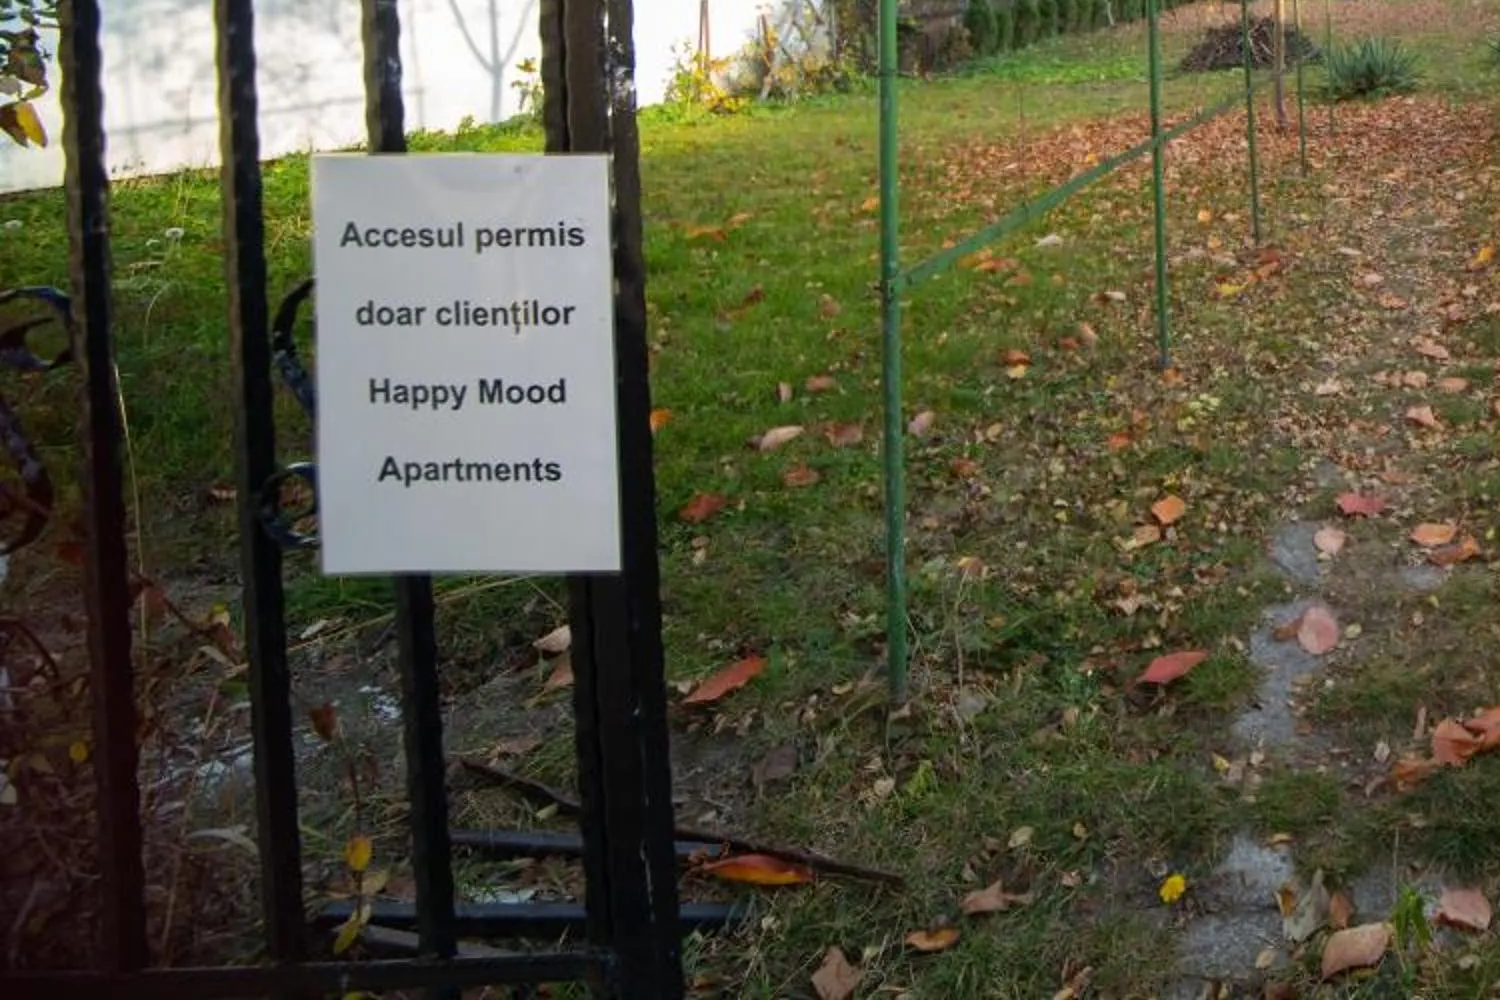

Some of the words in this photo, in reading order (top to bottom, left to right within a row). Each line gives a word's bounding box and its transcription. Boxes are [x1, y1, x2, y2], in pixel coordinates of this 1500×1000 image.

[340, 221, 464, 248] Accesul
[476, 221, 585, 254] permis
[356, 300, 426, 326] doar
[435, 299, 576, 334] clienților
[369, 378, 467, 411] Happy
[478, 378, 566, 405] Mood
[377, 455, 562, 488] Apartments
